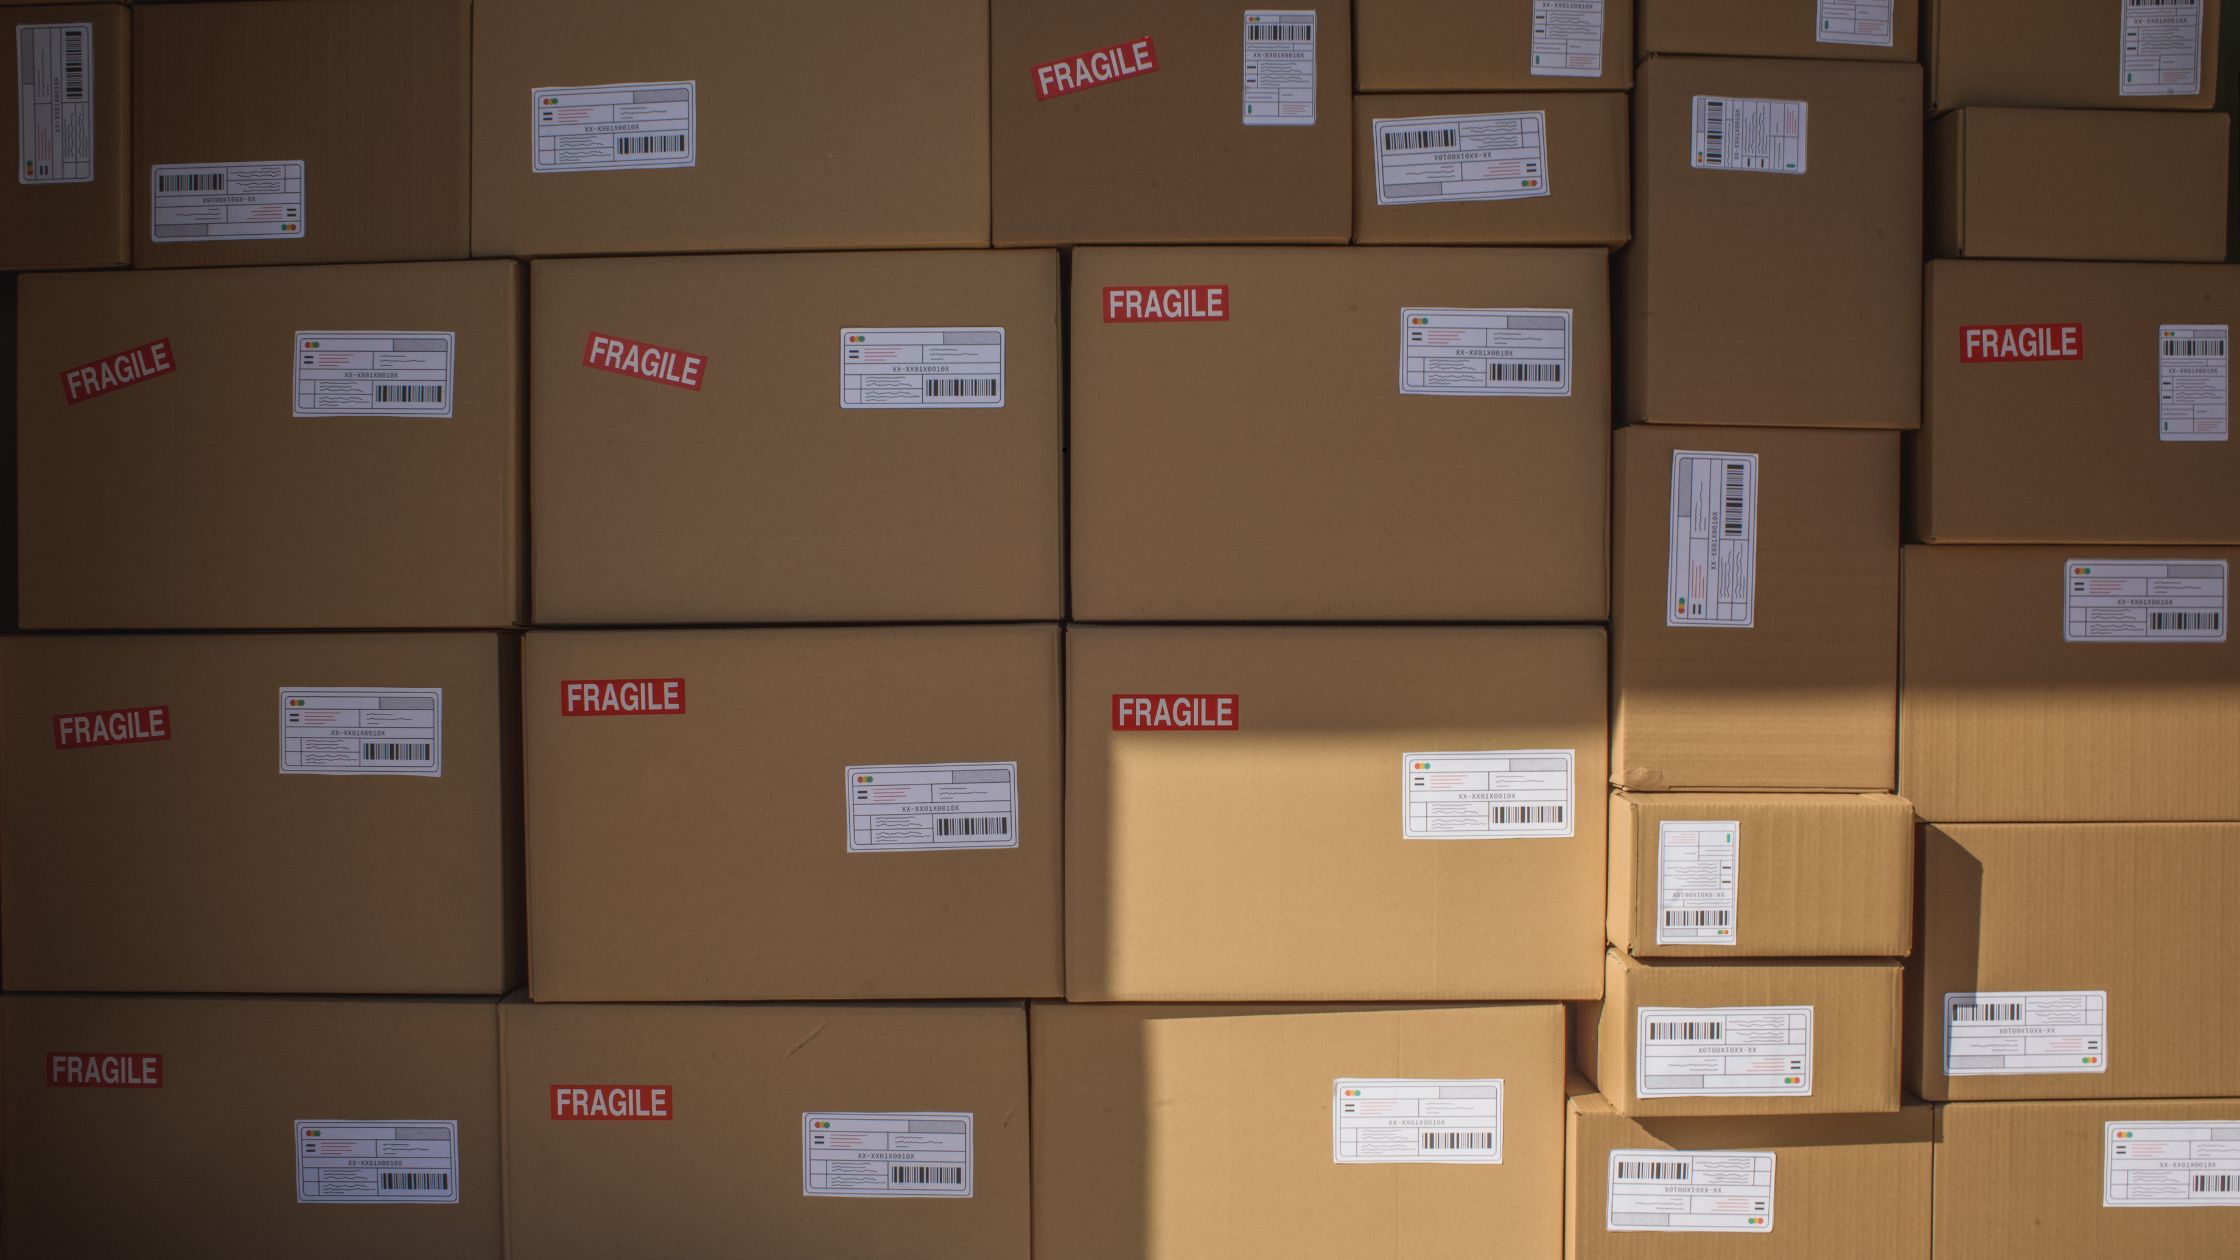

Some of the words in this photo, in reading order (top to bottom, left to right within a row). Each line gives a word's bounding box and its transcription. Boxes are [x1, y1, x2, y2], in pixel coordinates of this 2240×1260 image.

[1038, 41, 1153, 95] FRAGILE
[1109, 288, 1223, 319] FRAGILE
[1966, 326, 2078, 358] FRAGILE
[66, 342, 170, 398] FRAGILE
[589, 337, 701, 386] FRAGILE
[567, 682, 680, 712] FRAGILE
[1119, 697, 1233, 727] FRAGILE
[60, 709, 165, 744] FRAGILE
[52, 1056, 157, 1085] FRAGILE
[557, 1088, 668, 1117] FRAGILE
